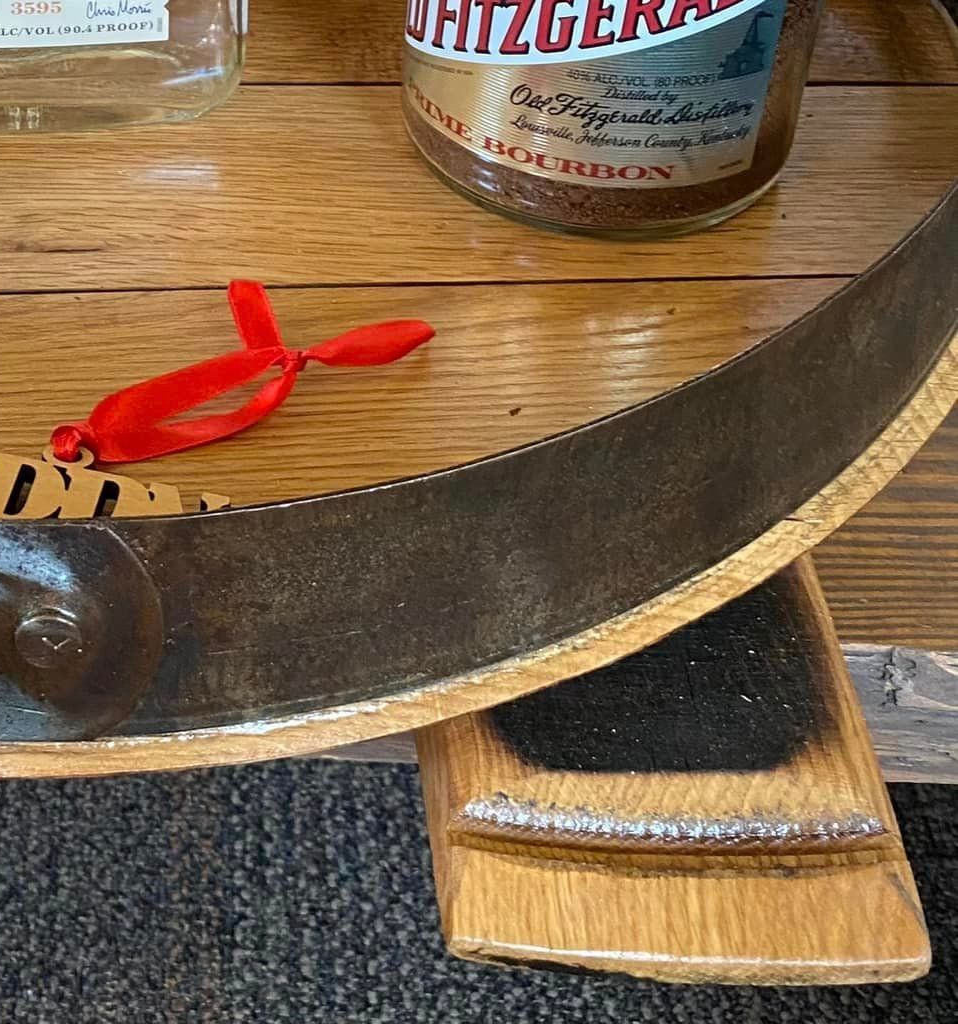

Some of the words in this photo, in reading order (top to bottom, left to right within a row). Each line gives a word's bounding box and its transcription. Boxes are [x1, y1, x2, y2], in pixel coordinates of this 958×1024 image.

[10, 1, 63, 16] 3595
[97, 21, 154, 33] PROOF)
[509, 83, 549, 113] Old
[546, 92, 662, 130] Fitzgerald
[575, 128, 642, 150] Jefferson
[482, 135, 676, 182] BOURBON
